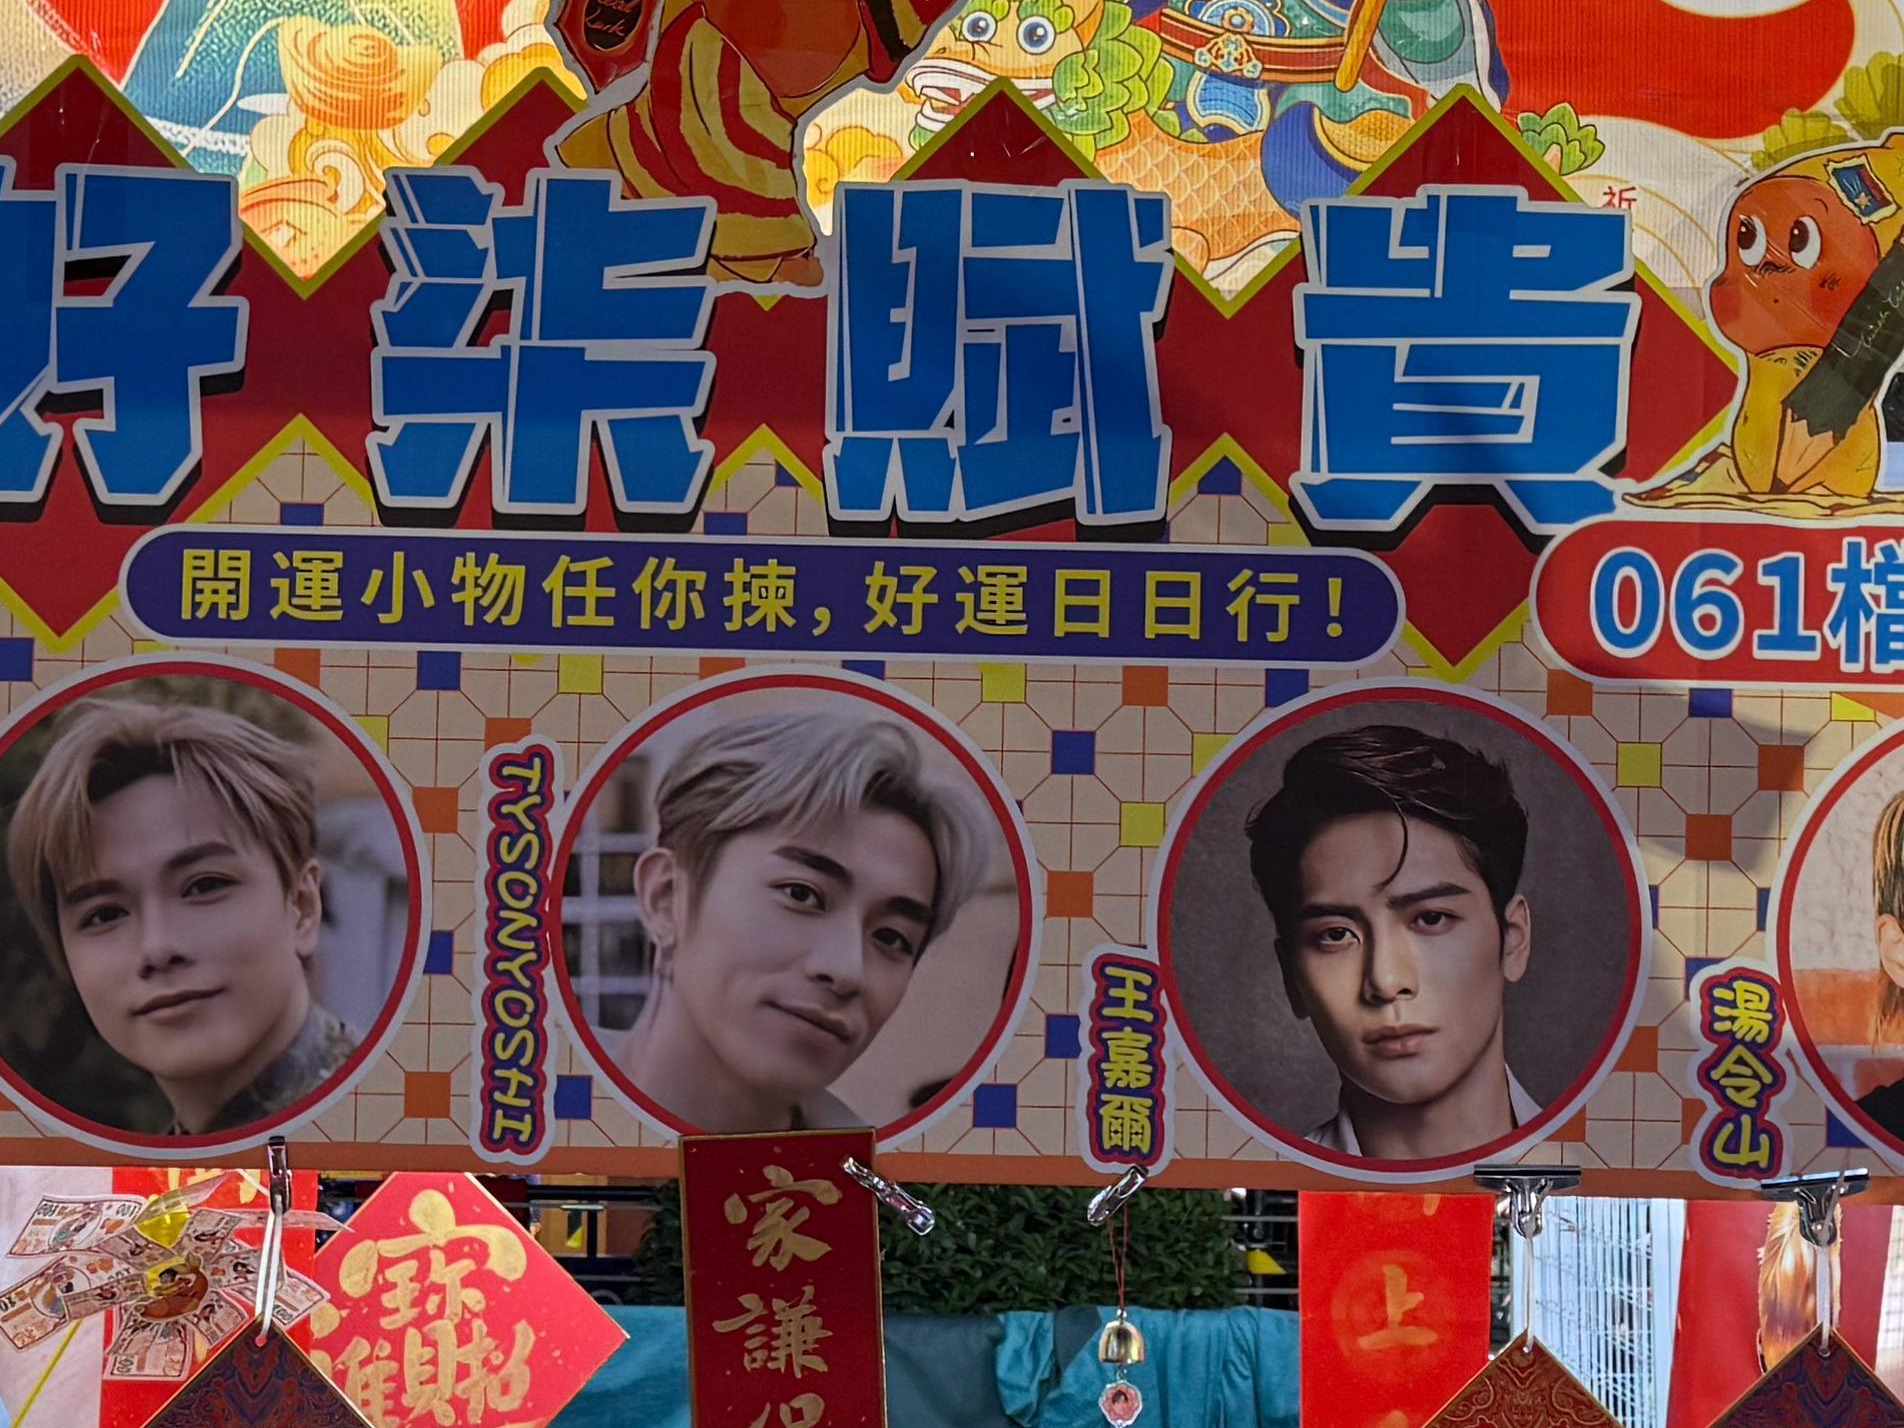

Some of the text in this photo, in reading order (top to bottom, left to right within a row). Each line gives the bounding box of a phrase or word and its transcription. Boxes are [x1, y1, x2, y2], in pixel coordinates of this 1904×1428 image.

[493, 754, 544, 1143] TYSONYOSHI
[1098, 964, 1155, 1153] 王嘉爾
[1708, 979, 1776, 1171] 湯令山
